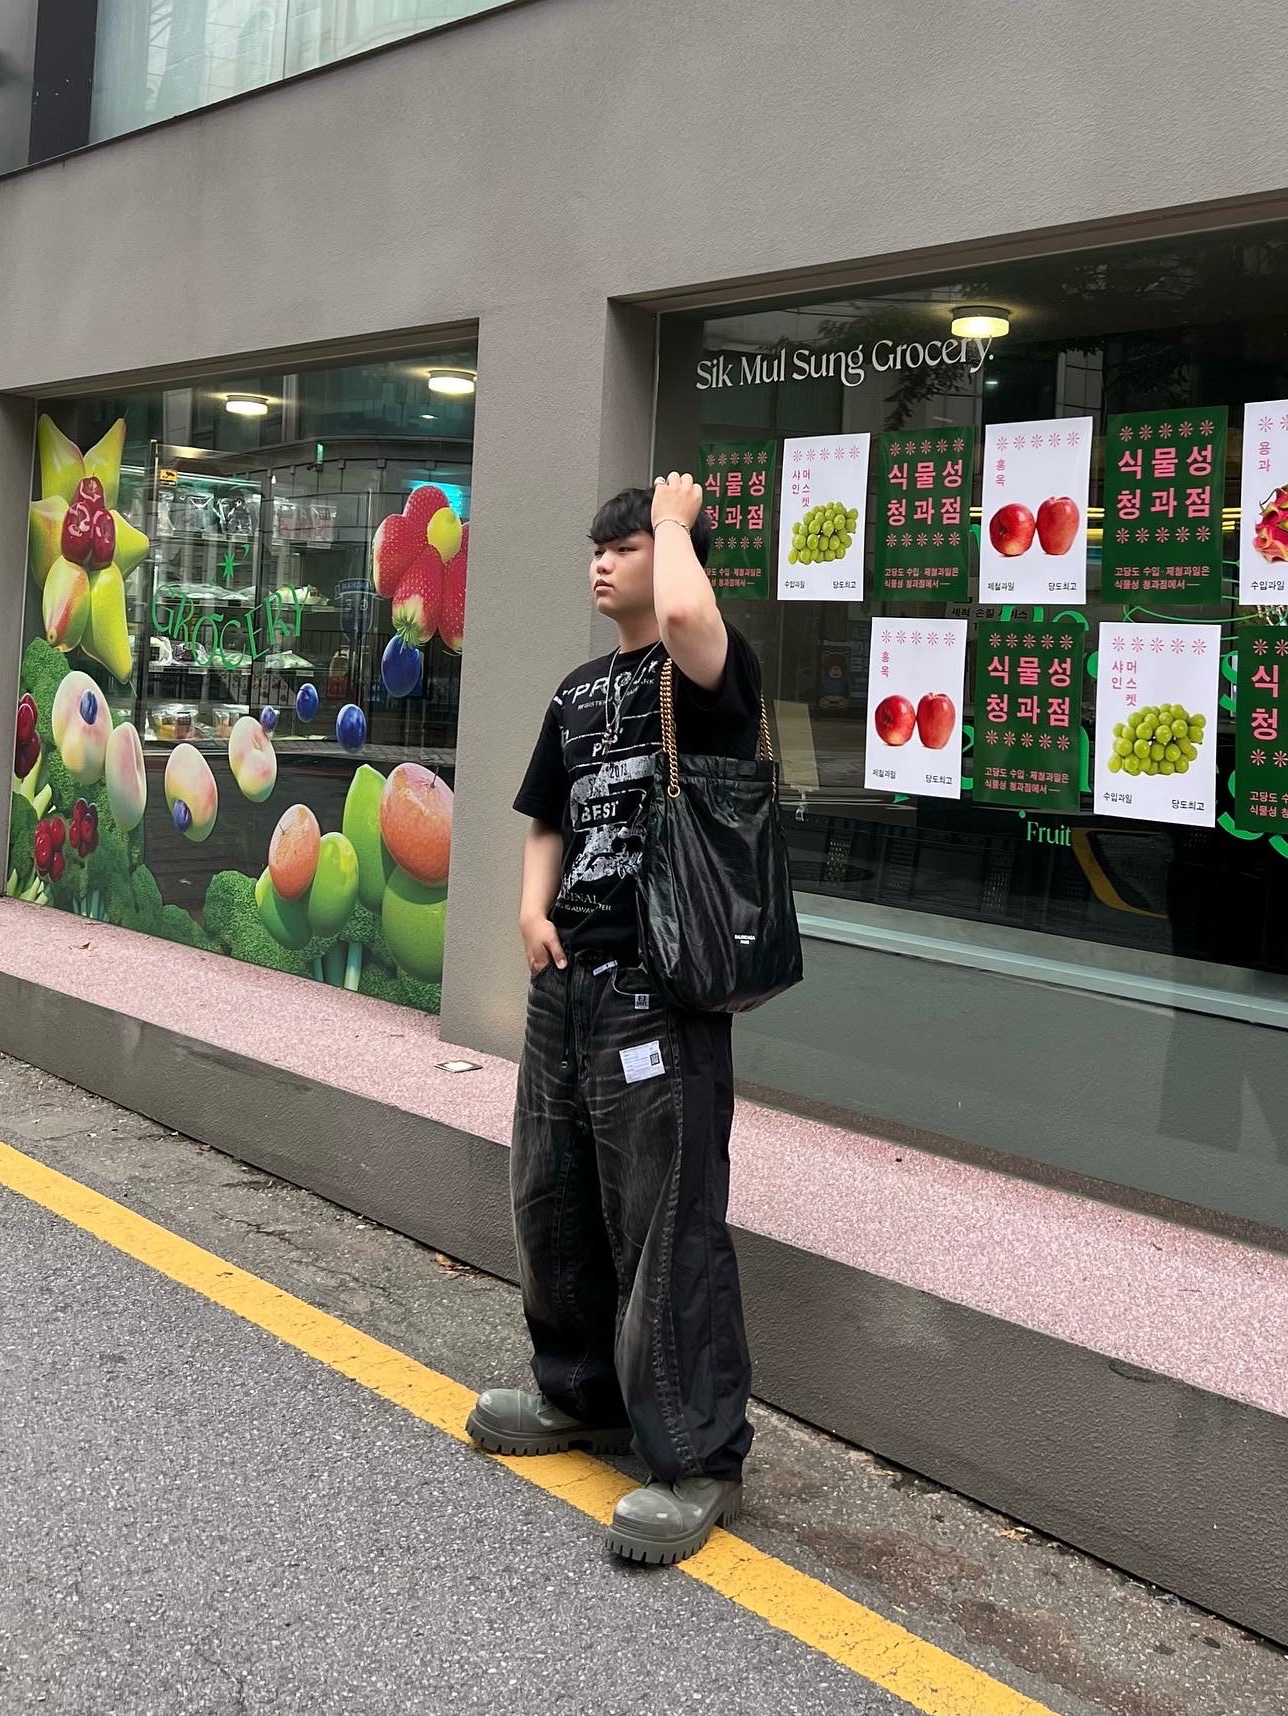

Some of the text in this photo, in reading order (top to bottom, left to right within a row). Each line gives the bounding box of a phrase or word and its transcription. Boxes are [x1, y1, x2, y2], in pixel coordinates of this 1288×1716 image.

[696, 355, 733, 390] Sik
[739, 348, 787, 386] Mul
[792, 344, 865, 387] Sung
[1117, 444, 1213, 480] 식물성
[1258, 441, 1272, 472] 용과
[705, 471, 766, 498] 식물성
[888, 459, 963, 490] 식물성
[886, 496, 961, 527] 청과점
[1116, 485, 1212, 520] 청과점
[1250, 580, 1285, 591] 수입과일
[152, 584, 310, 669] GROCERY
[987, 655, 1072, 687] 식물성
[1111, 661, 1124, 690] 샤인
[1125, 661, 1138, 707] 머스켓
[986, 693, 1070, 728] 청과점
[581, 801, 619, 823] BEST
[1103, 791, 1133, 804] 수입과일
[1250, 791, 1277, 803] 고당도
[1026, 821, 1072, 847] Fruit
